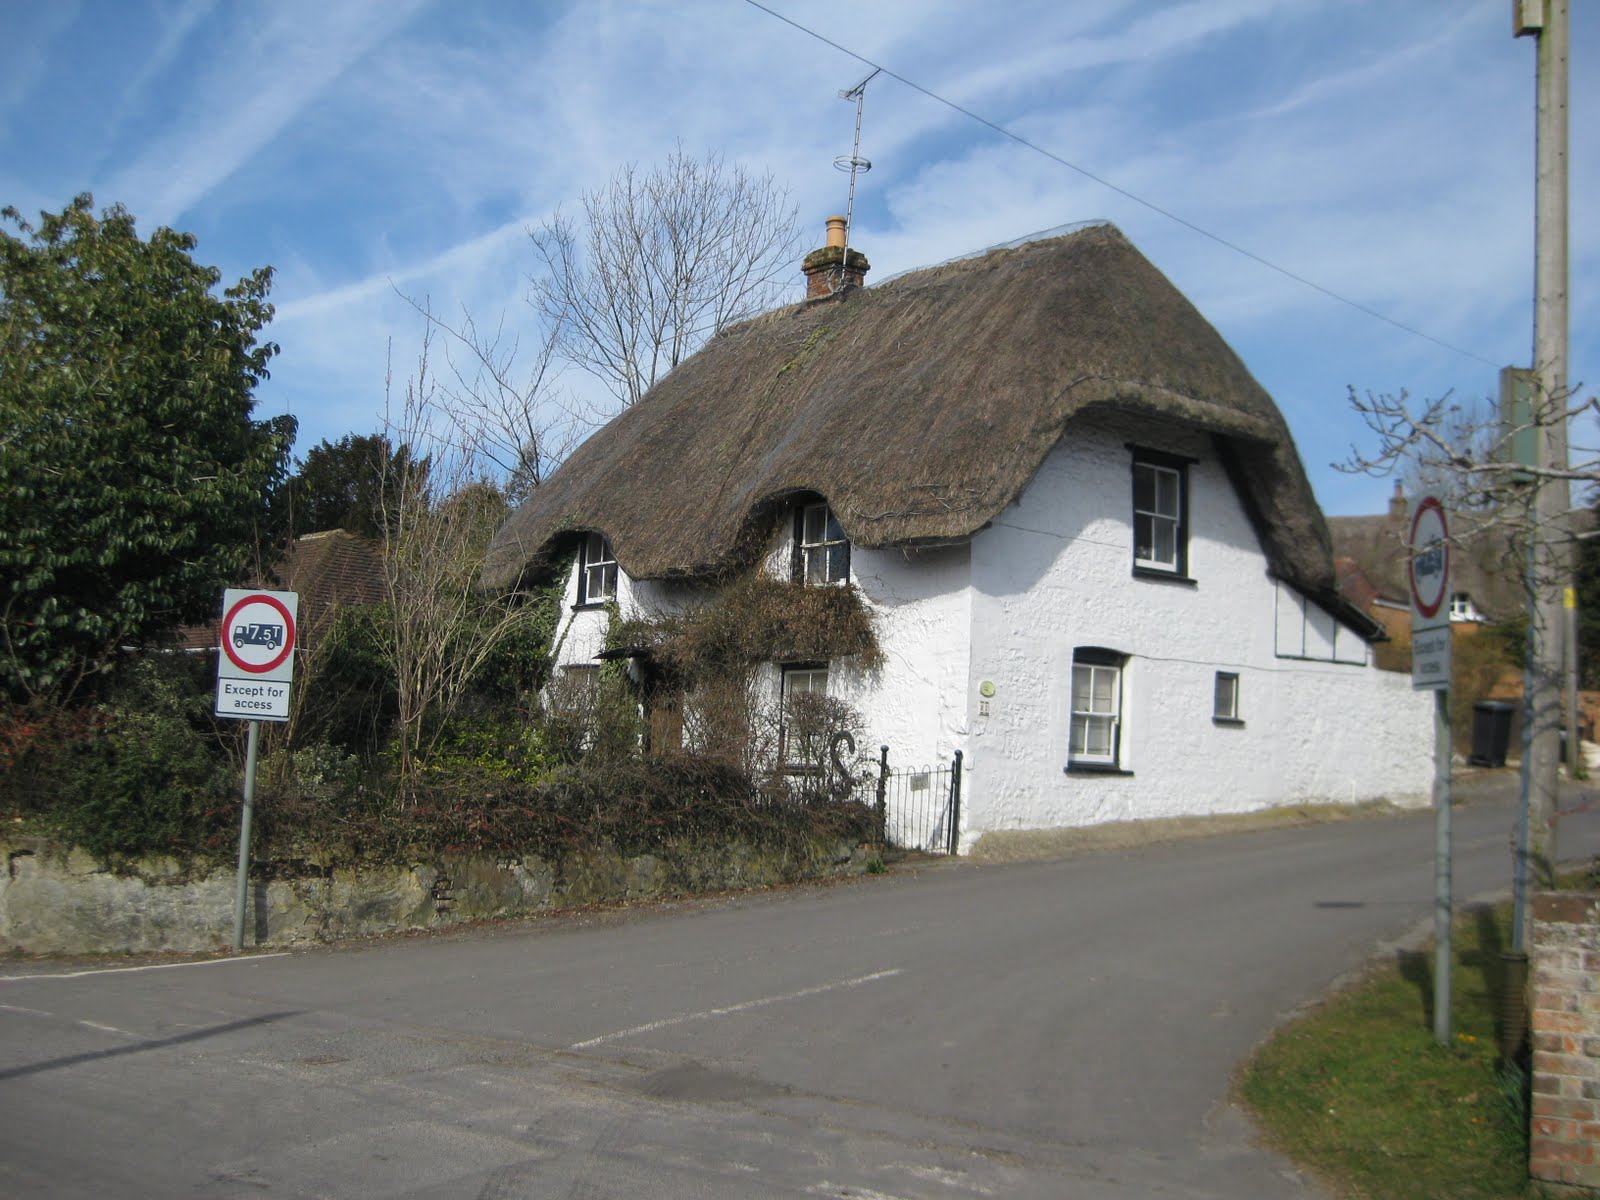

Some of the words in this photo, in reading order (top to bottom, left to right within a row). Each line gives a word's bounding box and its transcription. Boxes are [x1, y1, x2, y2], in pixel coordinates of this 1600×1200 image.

[250, 625, 280, 640] 7.5T
[225, 684, 264, 697] Except
[267, 687, 284, 697] for
[234, 700, 272, 709] access
